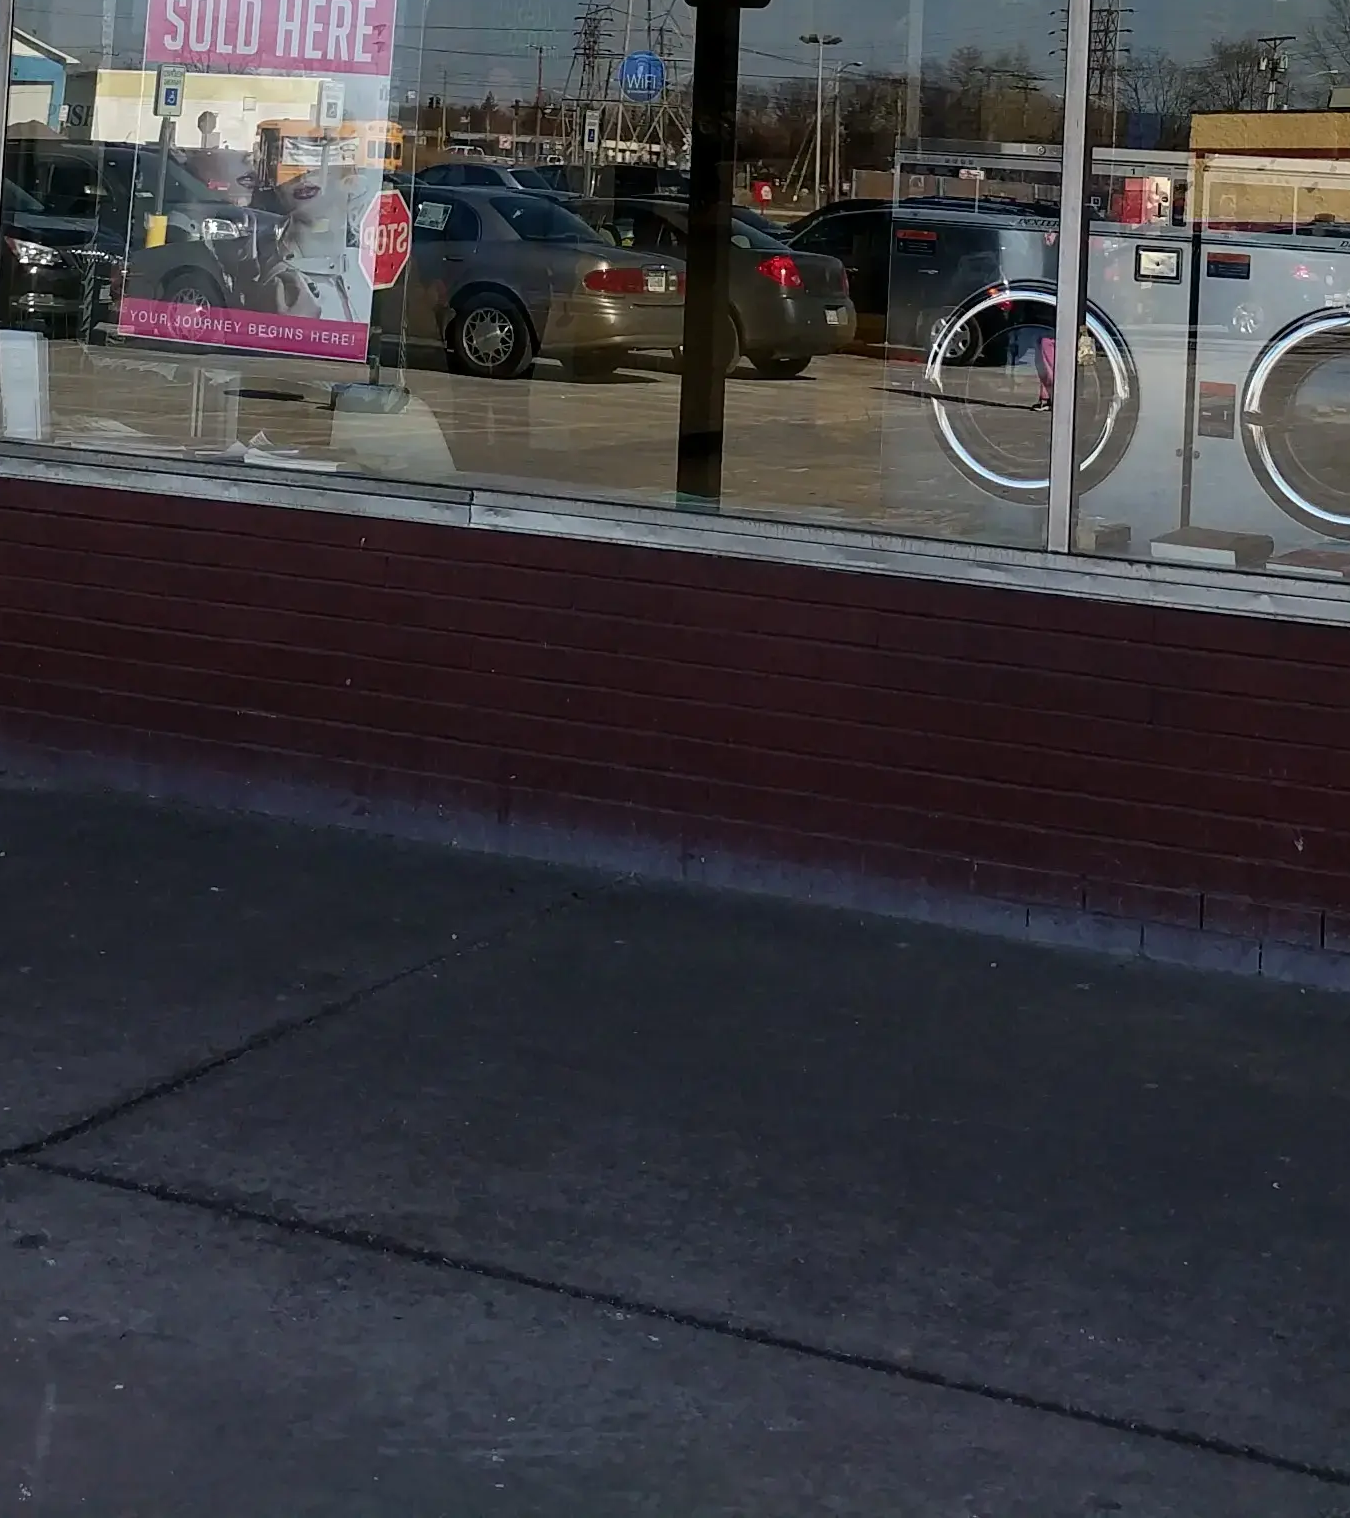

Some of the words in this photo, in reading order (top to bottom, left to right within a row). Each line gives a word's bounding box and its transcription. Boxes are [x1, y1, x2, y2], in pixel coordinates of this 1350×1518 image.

[626, 73, 657, 89] WiFi
[130, 309, 168, 327] YOUR
[175, 314, 242, 333] JOURNEY
[248, 323, 304, 340] BEGINS
[310, 330, 356, 347] HERE!
